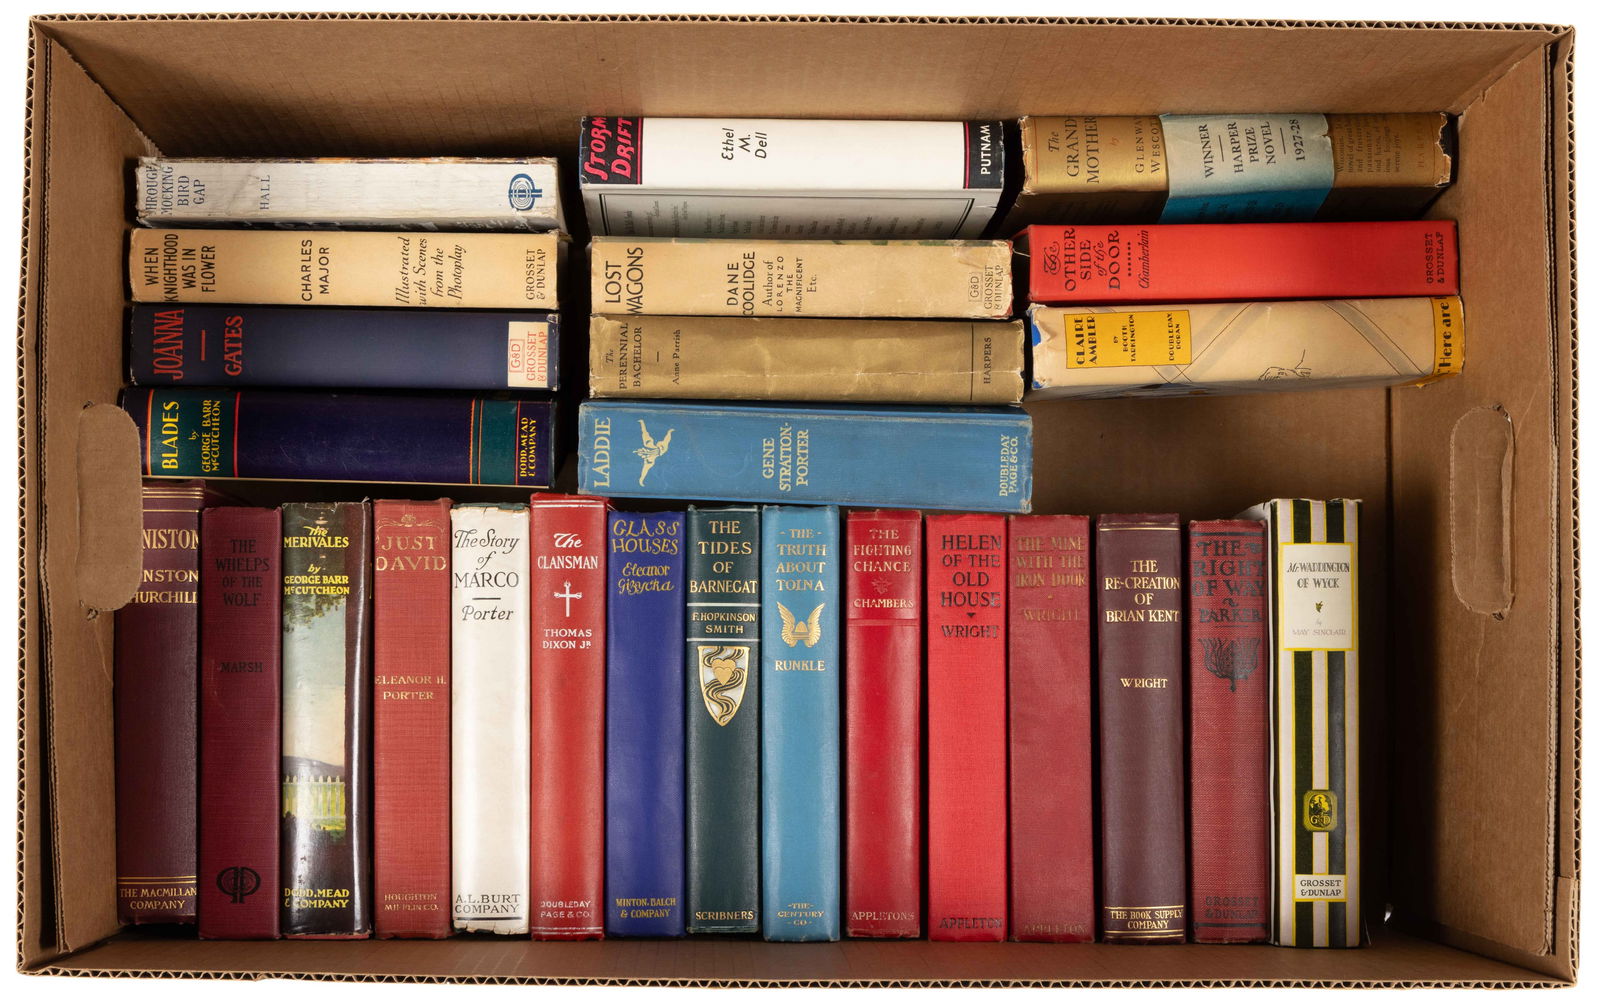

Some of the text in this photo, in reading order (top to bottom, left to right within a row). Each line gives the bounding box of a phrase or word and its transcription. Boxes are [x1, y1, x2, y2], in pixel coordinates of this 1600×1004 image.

[584, 117, 612, 180] STORM
[611, 118, 634, 179] DRIFT
[722, 127, 734, 160] Ethel
[739, 134, 750, 152] M.
[755, 132, 767, 158] Dell
[1048, 132, 1059, 152] The
[1065, 118, 1079, 177] GRAND
[1228, 122, 1244, 174] HARPER
[1245, 127, 1259, 163] PRIZE
[1261, 121, 1276, 165] NOVEL
[1289, 119, 1305, 161] 1927-28
[981, 125, 991, 174] PUTNAM
[1084, 117, 1099, 183] MOTHER
[1199, 123, 1214, 178] WINNER
[178, 176, 190, 206] BIRD
[194, 179, 205, 204] GAP
[260, 175, 270, 210] HALL
[144, 248, 158, 286] WHEN
[164, 233, 179, 301] KNIGHTHOOD
[1064, 228, 1076, 291] OTHER
[1080, 239, 1091, 280] SIDE
[1093, 241, 1107, 276] of the
[1108, 230, 1120, 290] DOOR
[1137, 230, 1149, 289] Chamberlain
[182, 249, 195, 289] WAS IN
[201, 246, 215, 292] FLOWER
[302, 239, 312, 301] CHARLES
[319, 247, 329, 294] MAJOR
[396, 237, 410, 304] Illustrated
[413, 239, 427, 305] with Scenes
[430, 248, 444, 297] from the
[447, 245, 466, 299] Photoplay
[526, 250, 535, 300] GROSSET
[537, 249, 546, 288] DUNLAP
[605, 261, 621, 303] LOST
[627, 247, 643, 314] WAGONS
[727, 262, 739, 306] DANE
[743, 252, 755, 315] COOLIDGE
[763, 261, 773, 306] Author of
[807, 274, 817, 292] Etc.
[153, 309, 184, 380] JOANNA
[224, 316, 243, 375] GATES
[1074, 317, 1085, 365] CLAIRE
[1087, 316, 1097, 364] AMBLER
[619, 323, 628, 389] PERENNIAL
[633, 327, 642, 387] BACHELOR
[162, 401, 179, 469] BLADES
[201, 400, 211, 472] GEORGE BARR
[212, 401, 220, 471] McCUTCHEON
[592, 417, 611, 488] LADDIE
[762, 437, 774, 479] GENE
[796, 429, 809, 486] PORTER
[999, 435, 1009, 496] DOUBLEDAY
[1009, 436, 1018, 493] PAGE & CO.
[303, 526, 329, 537] The
[613, 518, 680, 536] GLASS
[709, 521, 741, 534] THE
[869, 530, 899, 540] THE
[229, 539, 257, 553] THE
[284, 537, 349, 548] MERIVALES
[382, 536, 438, 550] JUST
[454, 529, 520, 554] The Story
[554, 533, 583, 548] The
[612, 538, 679, 555] HOUSES
[698, 542, 752, 554] TIDES
[942, 535, 1001, 550] HELEN
[1196, 540, 1246, 557] THE
[777, 544, 826, 556] TRUTH
[853, 545, 912, 556] FIGHTING
[215, 558, 270, 571] WHELPS
[376, 557, 447, 571] DAVID
[476, 551, 496, 570] of
[538, 556, 598, 569] CLANSMAN
[622, 562, 670, 576] Eleanor
[712, 562, 734, 573] OF
[776, 562, 826, 573] ABOUT
[854, 561, 911, 572] CHANCE
[942, 555, 1000, 567] OF THE
[1130, 560, 1158, 573] THE
[1192, 560, 1266, 577] RIGHT
[1299, 563, 1350, 572] WADDINGTON
[222, 577, 262, 588] OF THE
[284, 575, 349, 584] GEORGE BARR
[454, 572, 519, 588] MARCO
[690, 580, 758, 593] BARNEGAT
[776, 580, 824, 591] TOLNA
[952, 572, 989, 586] OLD
[1105, 577, 1180, 589] RE-CREATION
[1297, 578, 1339, 588] OF WYCK
[284, 586, 350, 595] McCUTCHEON
[941, 592, 1001, 607] HOUSE
[1134, 593, 1154, 605] OF
[223, 593, 261, 607] WOLF
[853, 599, 914, 608] CHAMBERS
[462, 605, 513, 621] Porter
[701, 613, 756, 621] HOPKINSON
[1106, 610, 1179, 622] BRIAN KENT
[1199, 609, 1262, 622] PARKER
[544, 629, 592, 637] THOMAS
[705, 625, 743, 633] SMITH
[942, 625, 999, 638] WRIGHT
[220, 662, 263, 673] MARSH
[775, 660, 825, 671] RUNKLE
[375, 675, 446, 684] ELEANOR H.
[1120, 679, 1168, 688] WRIGHT
[383, 692, 433, 700] PORTER
[120, 887, 196, 897] THE MACMILLAN
[130, 900, 185, 909] COMPANY
[455, 904, 519, 913] COMPANY
[695, 911, 754, 920] SCRIBNERS
[851, 912, 915, 920] APPLETONS
[1110, 909, 1184, 919] THE BOOK SUPPLY
[1127, 921, 1169, 929] COMPANY
